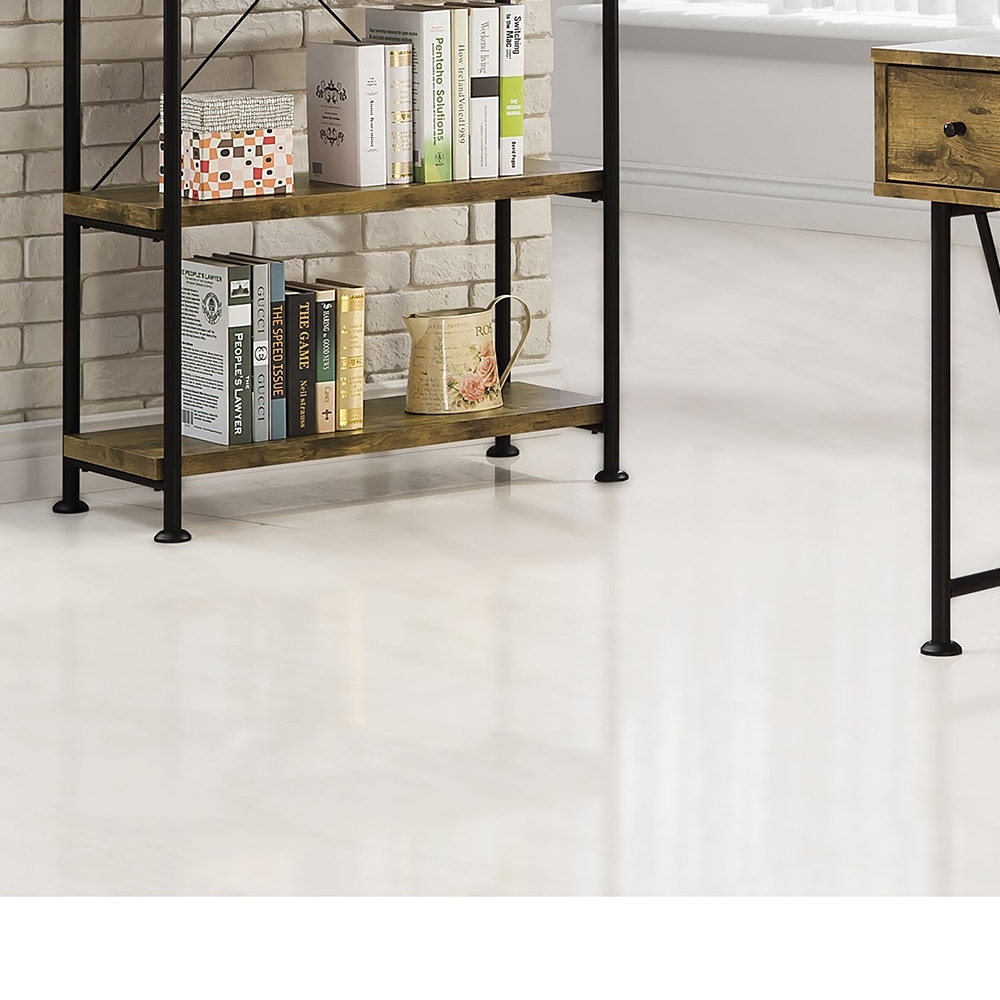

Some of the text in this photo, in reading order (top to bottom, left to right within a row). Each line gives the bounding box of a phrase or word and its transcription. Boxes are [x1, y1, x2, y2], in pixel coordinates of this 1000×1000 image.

[457, 44, 466, 64] How
[477, 20, 490, 74] Weekend living
[505, 30, 514, 48] Mac
[512, 15, 522, 55] Switching
[435, 37, 444, 85] Pentaho
[436, 89, 445, 142] Solutions
[257, 286, 265, 333] GUCCI
[272, 304, 284, 397] THE SPEED ISSUE
[299, 301, 310, 370] THE GAME
[234, 332, 244, 435] PEOPLE'S LAWYER
[257, 373, 265, 421] GUCCI
[299, 379, 308, 397] Neil
